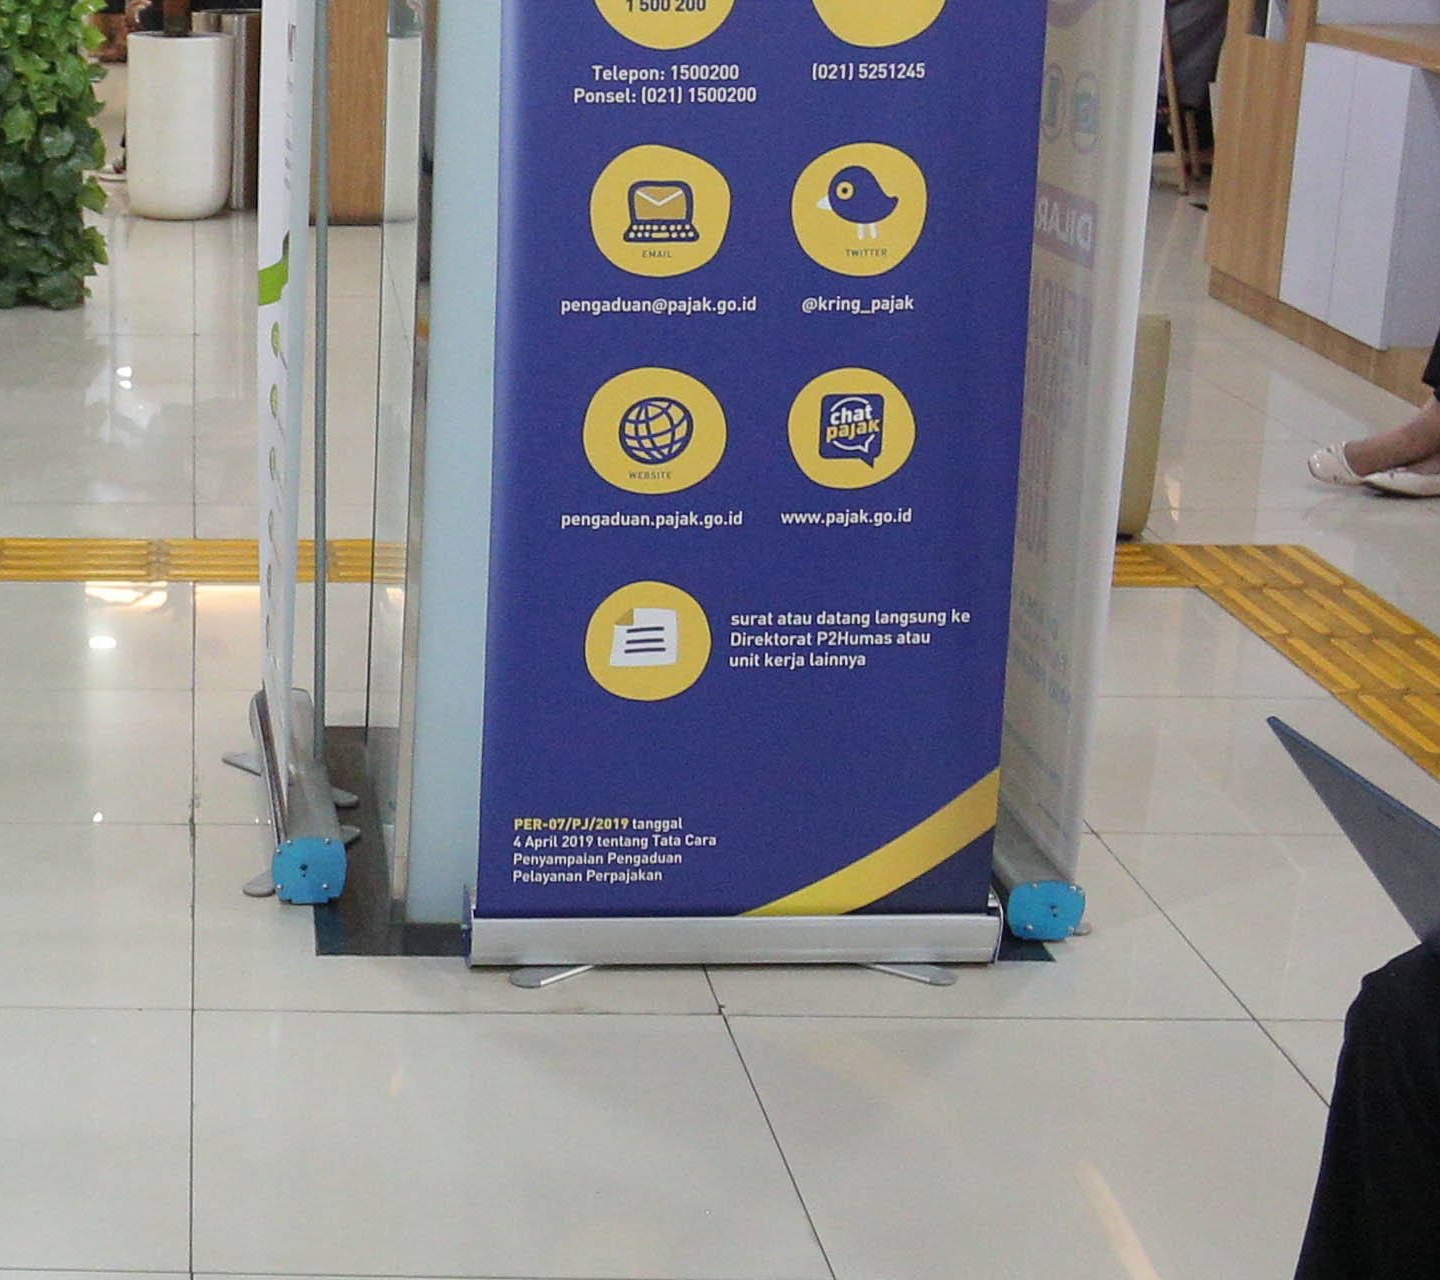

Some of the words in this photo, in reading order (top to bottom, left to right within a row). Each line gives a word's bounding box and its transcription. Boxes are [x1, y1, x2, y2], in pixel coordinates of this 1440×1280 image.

[592, 64, 665, 84] Telepon:
[670, 63, 740, 81] 1500200
[812, 62, 854, 81] (021)
[858, 63, 925, 80] 5251245
[573, 87, 636, 104] Ponsel:
[640, 86, 683, 105] (021)
[688, 87, 757, 104] 1500200
[641, 250, 672, 259] EMAIL
[845, 248, 888, 258] TWITTER
[561, 296, 757, 317] pengaduan@pajak.go.id
[801, 295, 915, 315] @kring_pajak
[829, 404, 873, 424] chat
[825, 420, 882, 443] pajak
[628, 471, 672, 480] WEBSITE
[561, 510, 744, 530] pengaduan.pajak.go.id
[780, 508, 913, 527] www.pajak.go.id
[731, 612, 773, 626] surat
[777, 612, 812, 626] atau
[817, 611, 870, 628] datang
[875, 610, 947, 627] langsung
[952, 610, 971, 624] ke
[730, 632, 812, 646] Direktorat
[817, 631, 893, 646] P2Humas
[897, 631, 931, 645] atau
[729, 653, 760, 667] unit
[765, 652, 805, 670] kerja
[810, 652, 866, 669] lainnya
[513, 818, 629, 832] PER-07/PJ/2019
[632, 817, 683, 833] tanggal
[513, 836, 521, 848] 4
[524, 835, 558, 851] April
[562, 836, 593, 848] 2019
[597, 835, 648, 850] tentang
[652, 834, 681, 847] Tata
[685, 834, 717, 847] Cara
[513, 852, 604, 869] Penyampaian
[608, 852, 682, 868] Pengaduan
[513, 869, 583, 885] Pelayanan
[586, 869, 663, 885] Perpajakan
